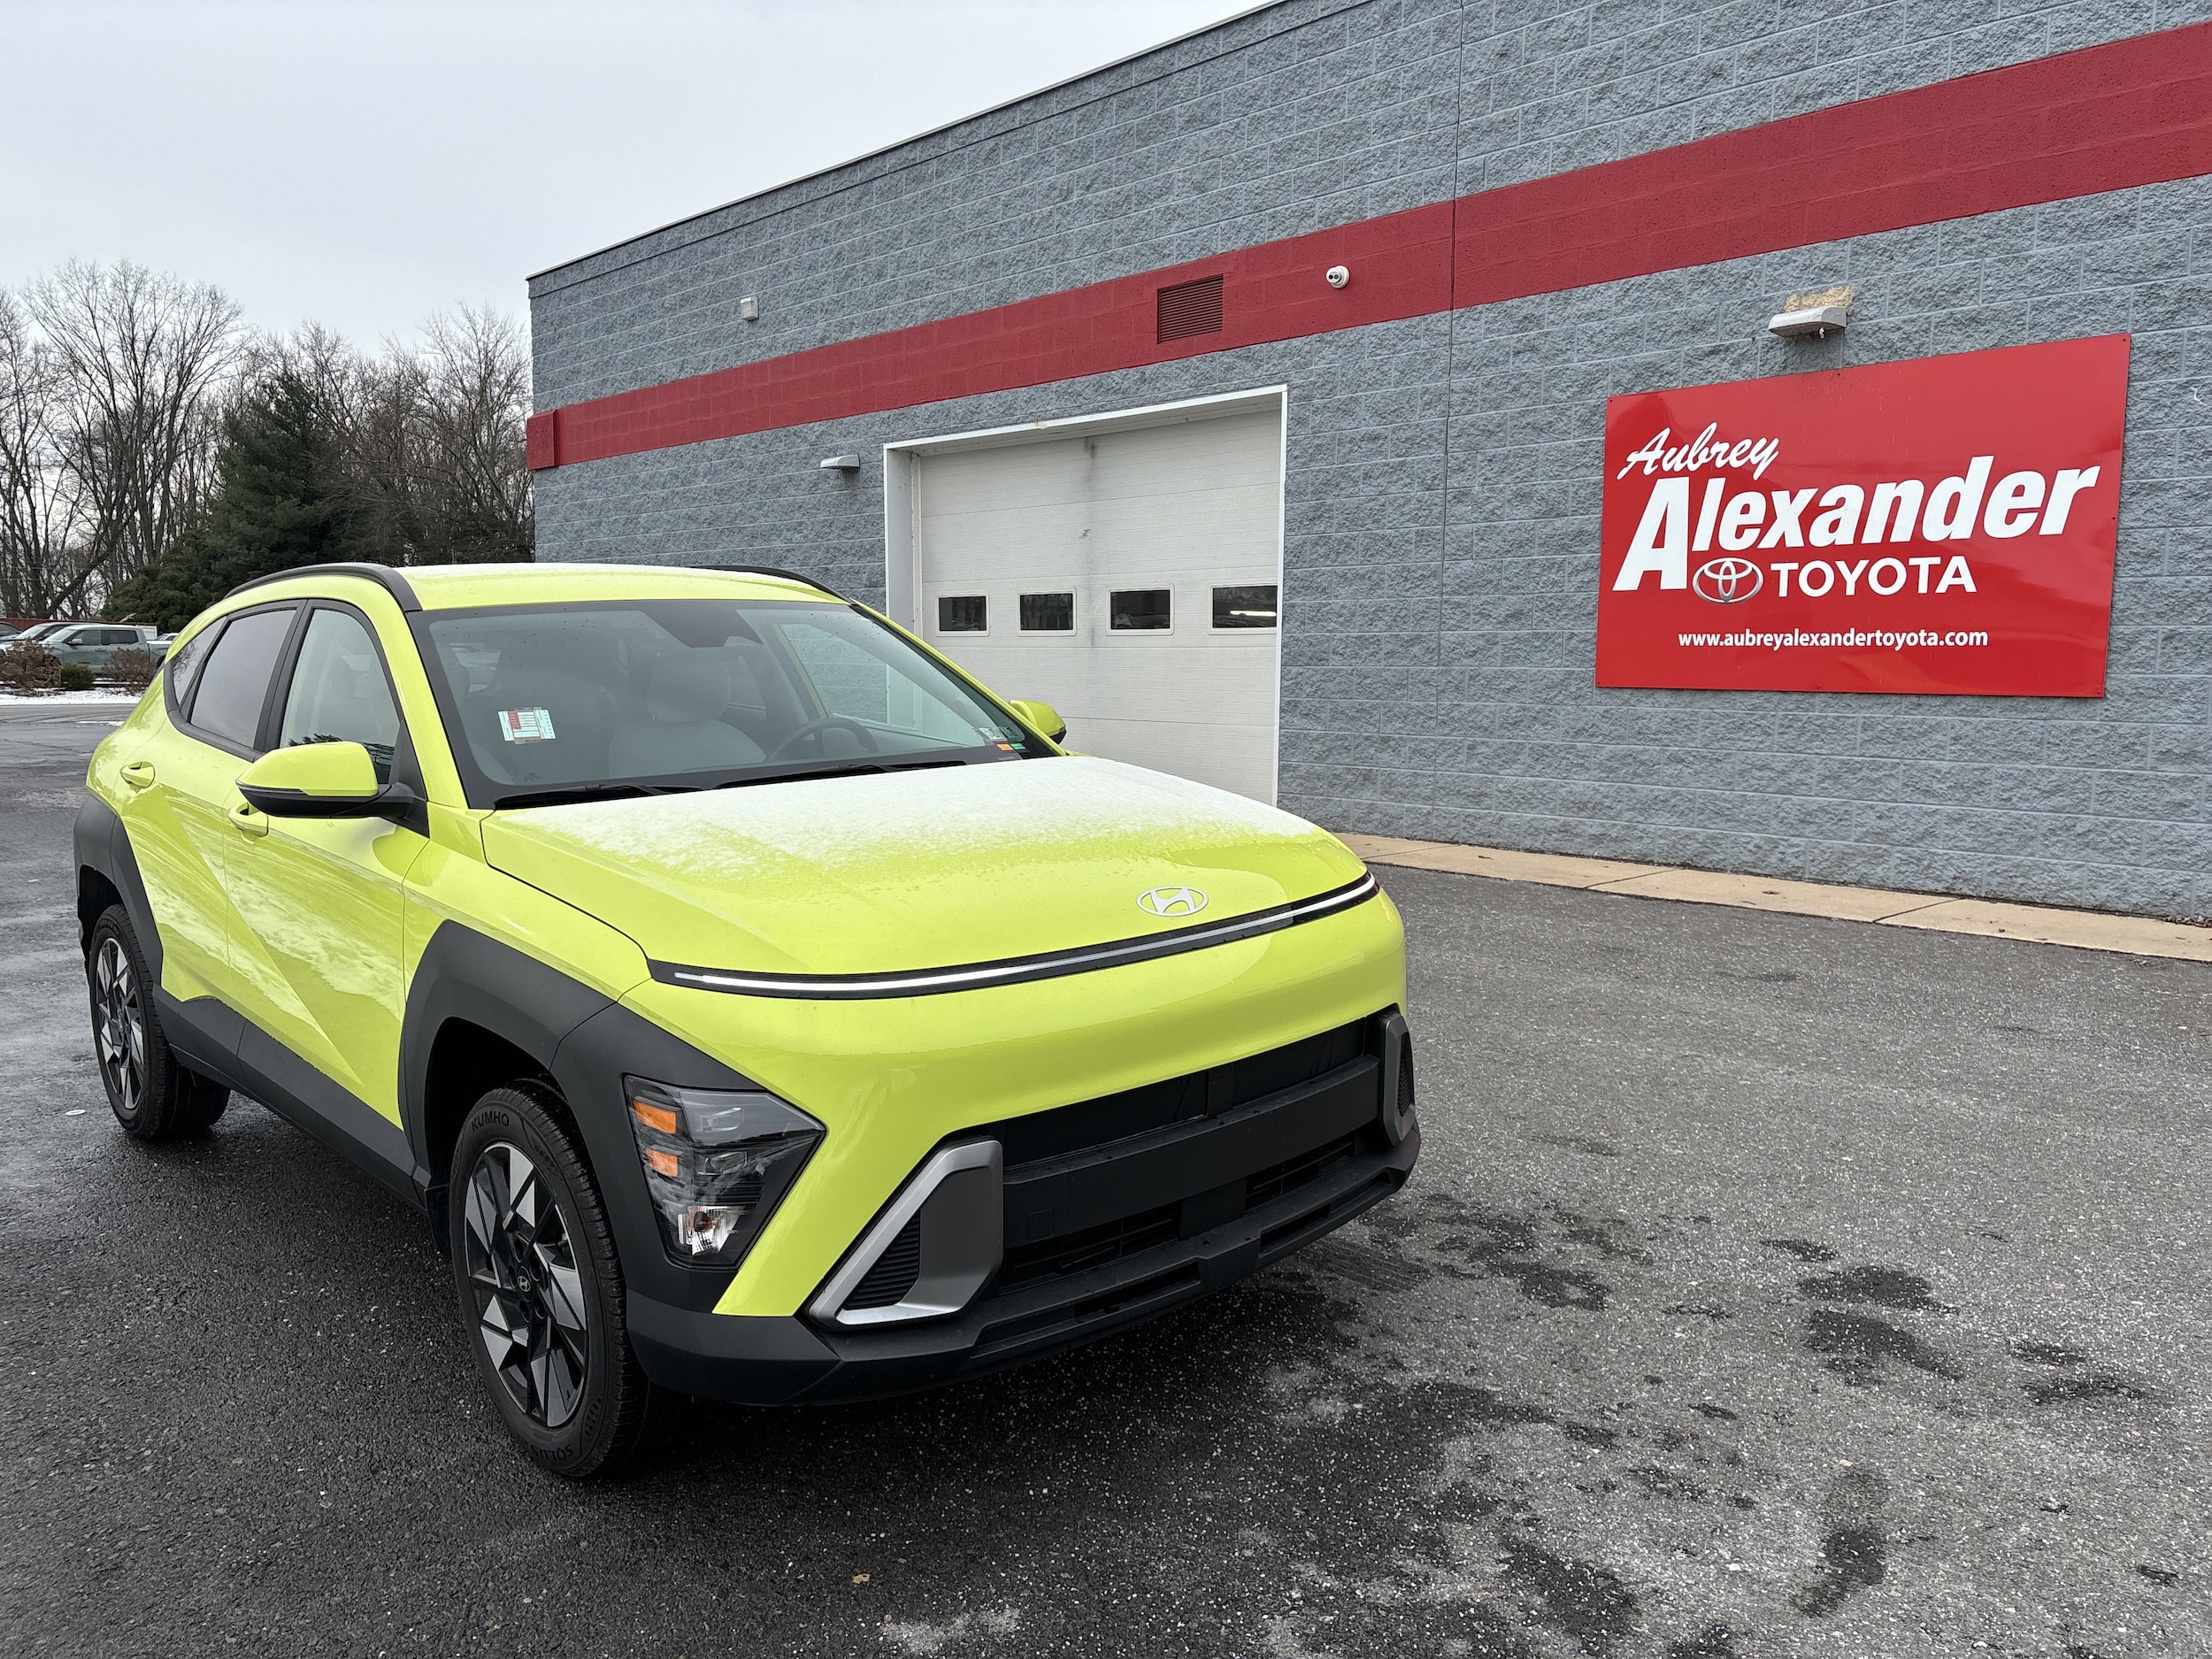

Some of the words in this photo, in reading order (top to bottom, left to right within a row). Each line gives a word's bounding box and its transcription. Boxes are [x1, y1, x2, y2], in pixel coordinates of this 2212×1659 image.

[1617, 421, 1780, 481] Aubrey
[1612, 454, 2102, 591] Alexander
[1770, 556, 1978, 597] TOYOTA
[1678, 627, 1989, 652] www.aubreyalexandertoyota.com
[471, 1110, 510, 1133] KUMHO
